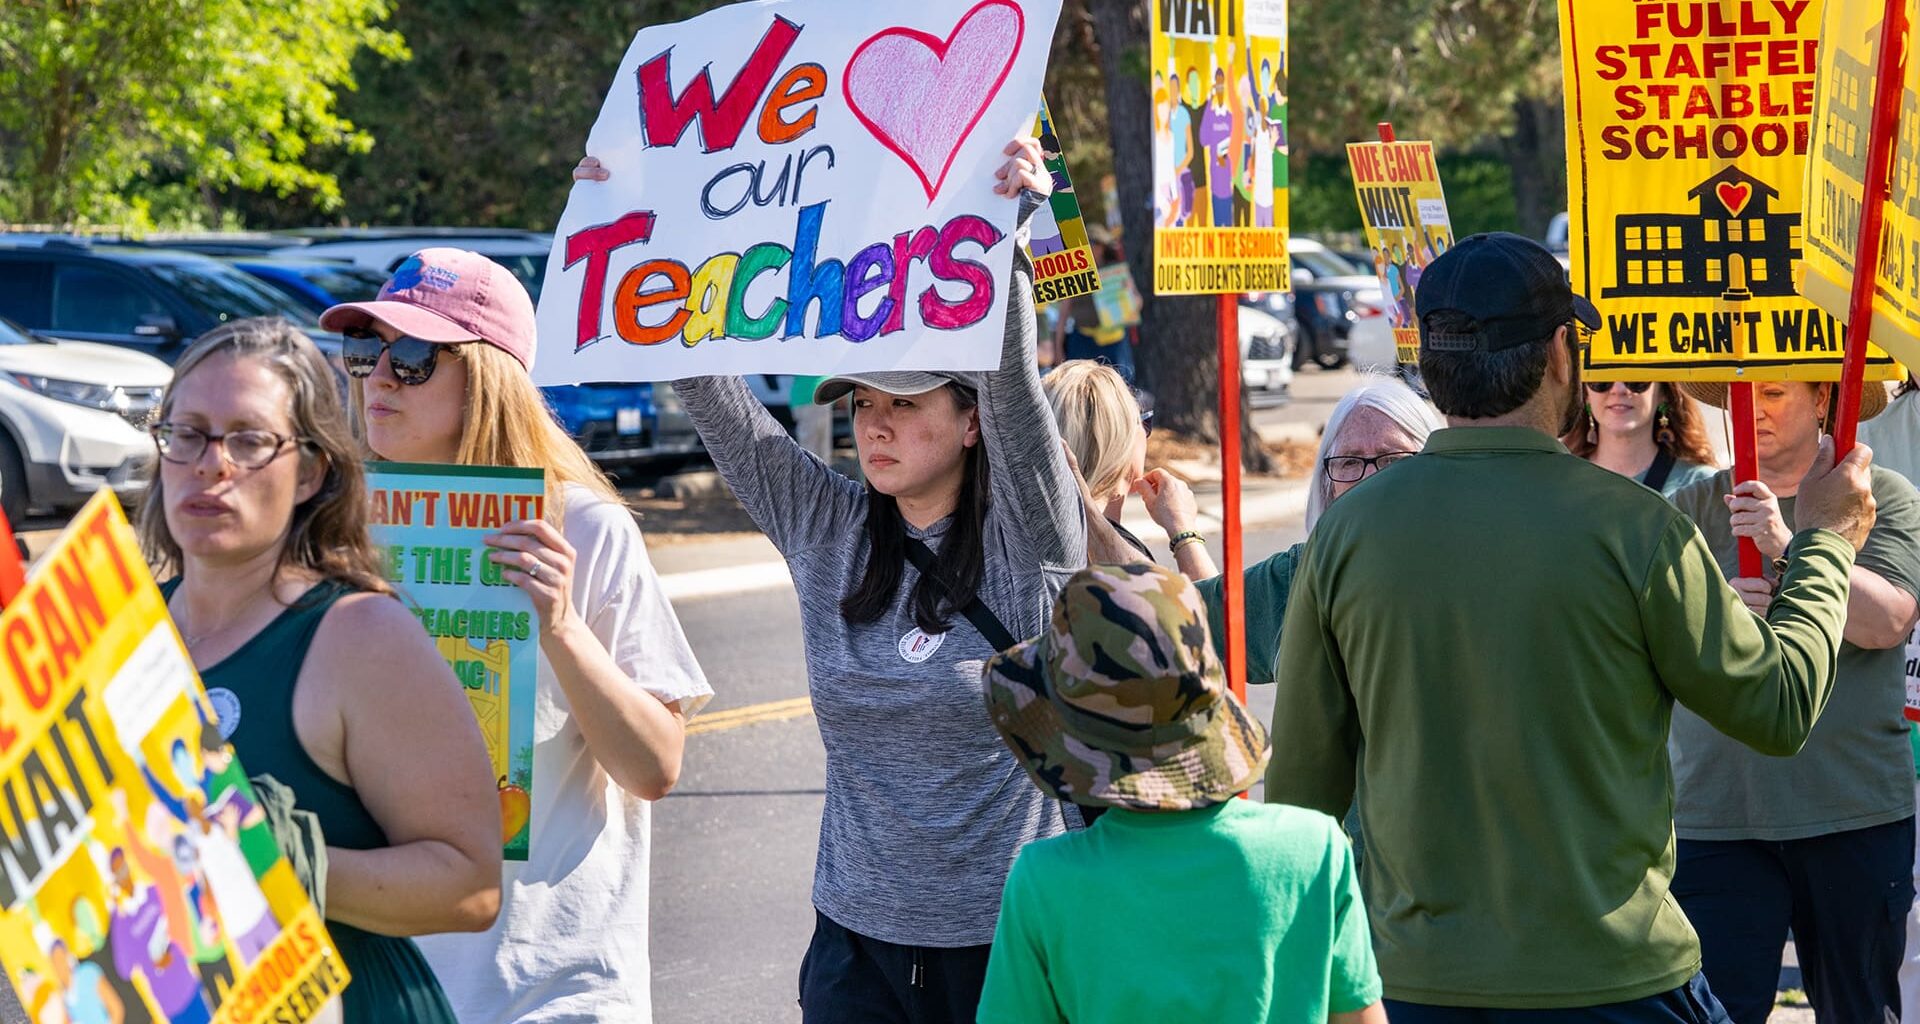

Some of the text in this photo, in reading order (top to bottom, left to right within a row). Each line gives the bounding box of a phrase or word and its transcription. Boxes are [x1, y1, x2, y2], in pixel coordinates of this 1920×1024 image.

[1636, 0, 1810, 39] FULLY
[636, 13, 828, 154] We
[1614, 81, 1814, 120] STABLE
[700, 144, 835, 220] our
[1349, 145, 1435, 183] WE CAN'T
[1359, 187, 1415, 228] WAIT
[1161, 231, 1284, 258] INVEST IN THE SCHOOLS
[562, 199, 1007, 354] Teachers
[1033, 249, 1089, 281] HOOLS
[1158, 263, 1287, 291] OUR STUDENTS DESERVE
[1032, 270, 1099, 304] ESERVE
[1608, 313, 1658, 355] WE
[1669, 311, 1762, 353] CAN'T
[368, 489, 440, 527] AN'T
[411, 547, 472, 585] THE
[4, 507, 135, 711] CAN'T
[0, 686, 115, 912] WAIT
[263, 958, 340, 1024] SERVE
